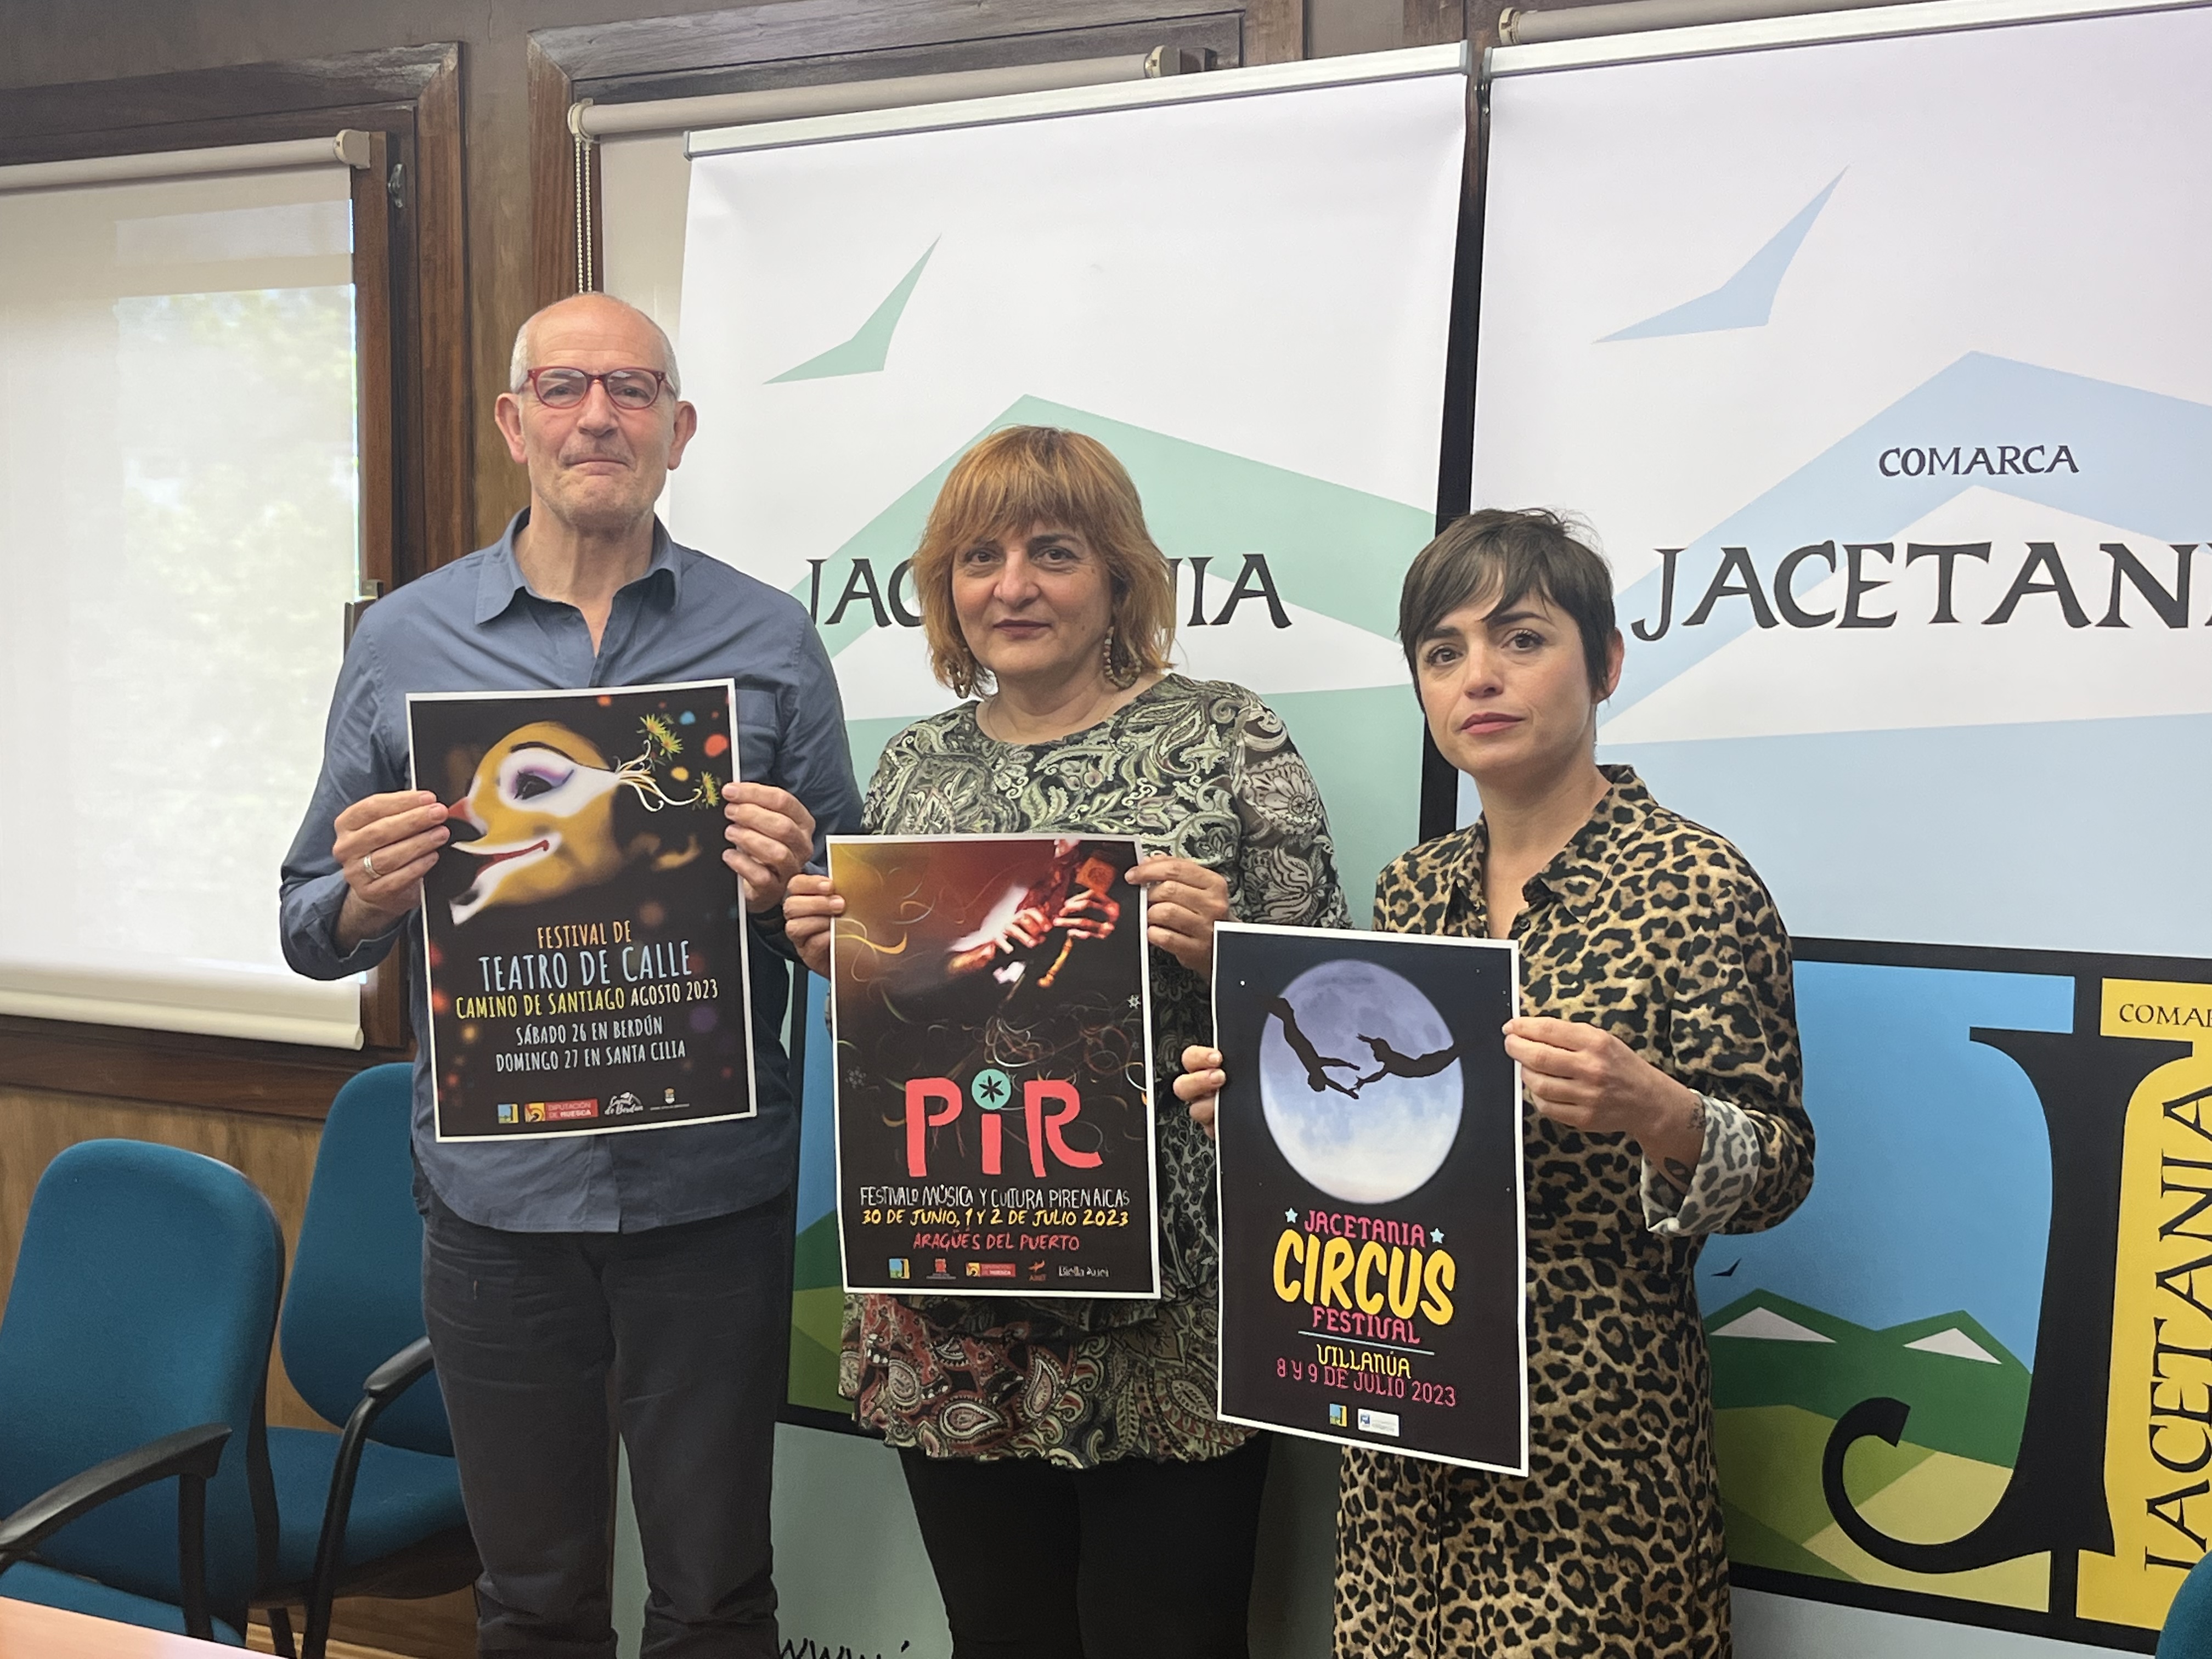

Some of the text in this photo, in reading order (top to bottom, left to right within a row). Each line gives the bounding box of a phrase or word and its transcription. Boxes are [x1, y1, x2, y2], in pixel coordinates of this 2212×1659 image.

[1879, 445, 2079, 477] COMARCA
[537, 920, 631, 949] FESTIVAL DE
[479, 940, 692, 992] TEATRO DE CALLE
[456, 978, 719, 1019] CAMINO DE SANTIAGO AGOSTO 2023
[516, 1014, 663, 1046] SÁBADO 26 EN BERDÚN
[496, 1040, 686, 1072] DOMINGO 27 EN SANTA CILIA
[922, 1184, 974, 1207] MÚSICA
[979, 1188, 988, 1206] Y
[991, 1188, 1044, 1209] CULTURA
[861, 1207, 1128, 1227] 30 DE JUNIO, 1 Y 2 DE JULIO 2023
[1304, 1210, 1425, 1247] JACETANIA
[913, 1227, 1080, 1251] ARAGÜÉS DEL PUERTO
[1273, 1229, 1455, 1325] CIRCUS
[1313, 1307, 1420, 1344] FESTIVAL
[1277, 1358, 1457, 1407] 8 Y 9 DE JULIO 2023
